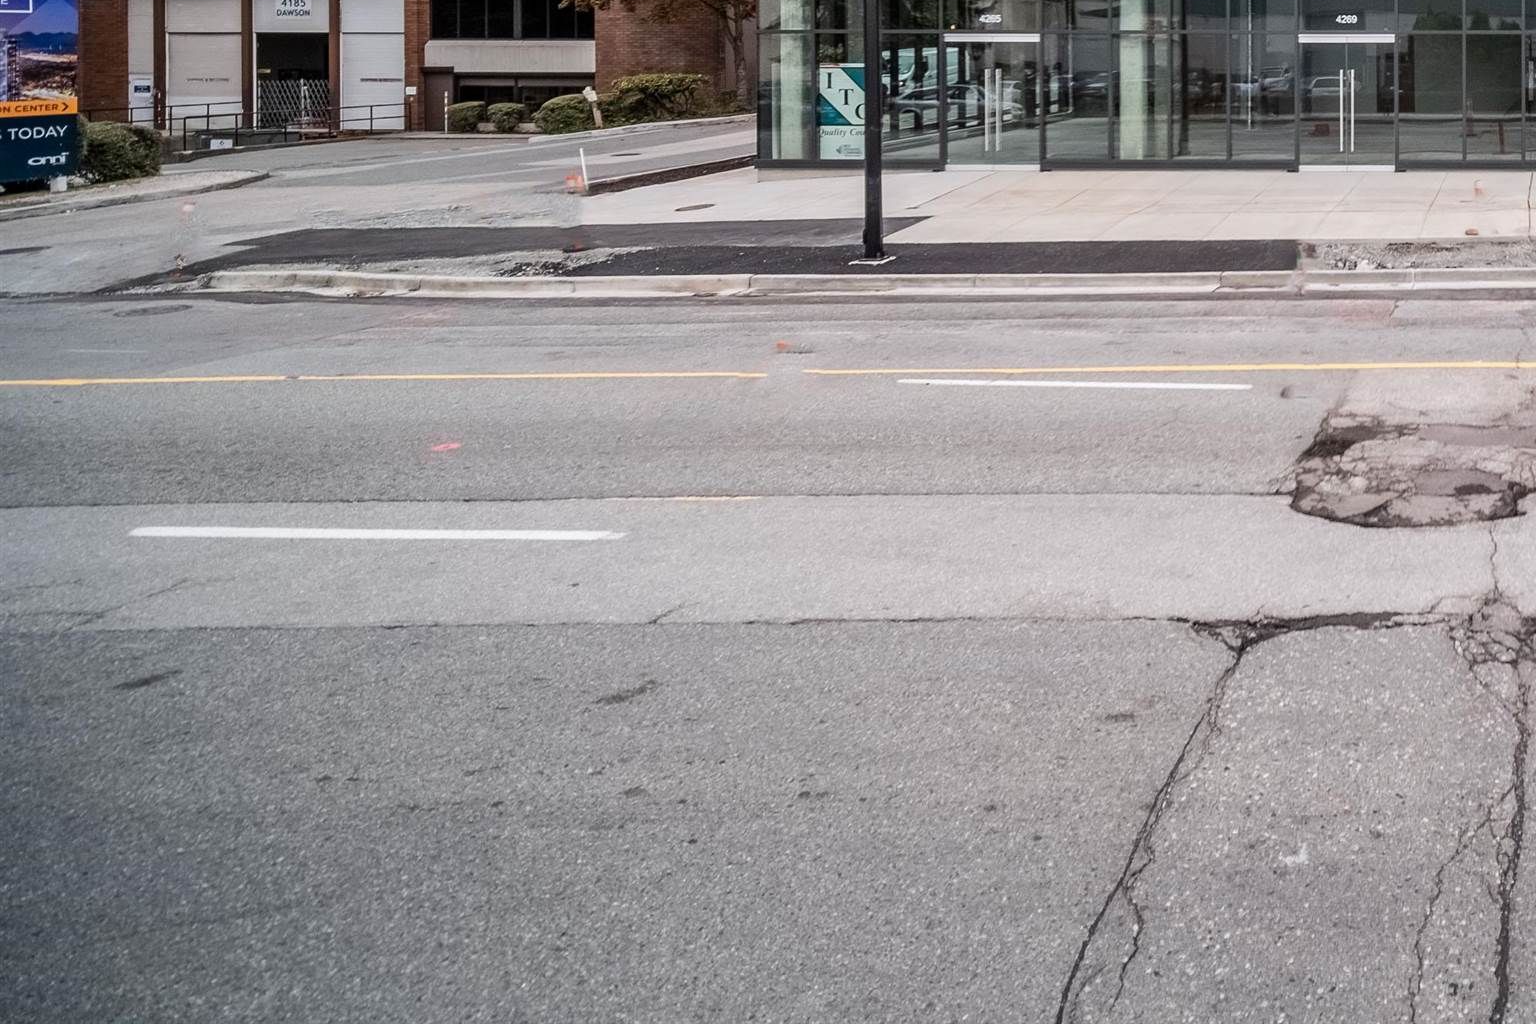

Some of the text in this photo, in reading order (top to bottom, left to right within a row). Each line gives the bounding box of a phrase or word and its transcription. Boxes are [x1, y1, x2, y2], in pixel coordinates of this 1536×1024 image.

[276, 9, 311, 17] DAWSON
[1335, 14, 1358, 24] 4269
[14, 104, 58, 113] CENTER
[8, 125, 68, 140] TODAY
